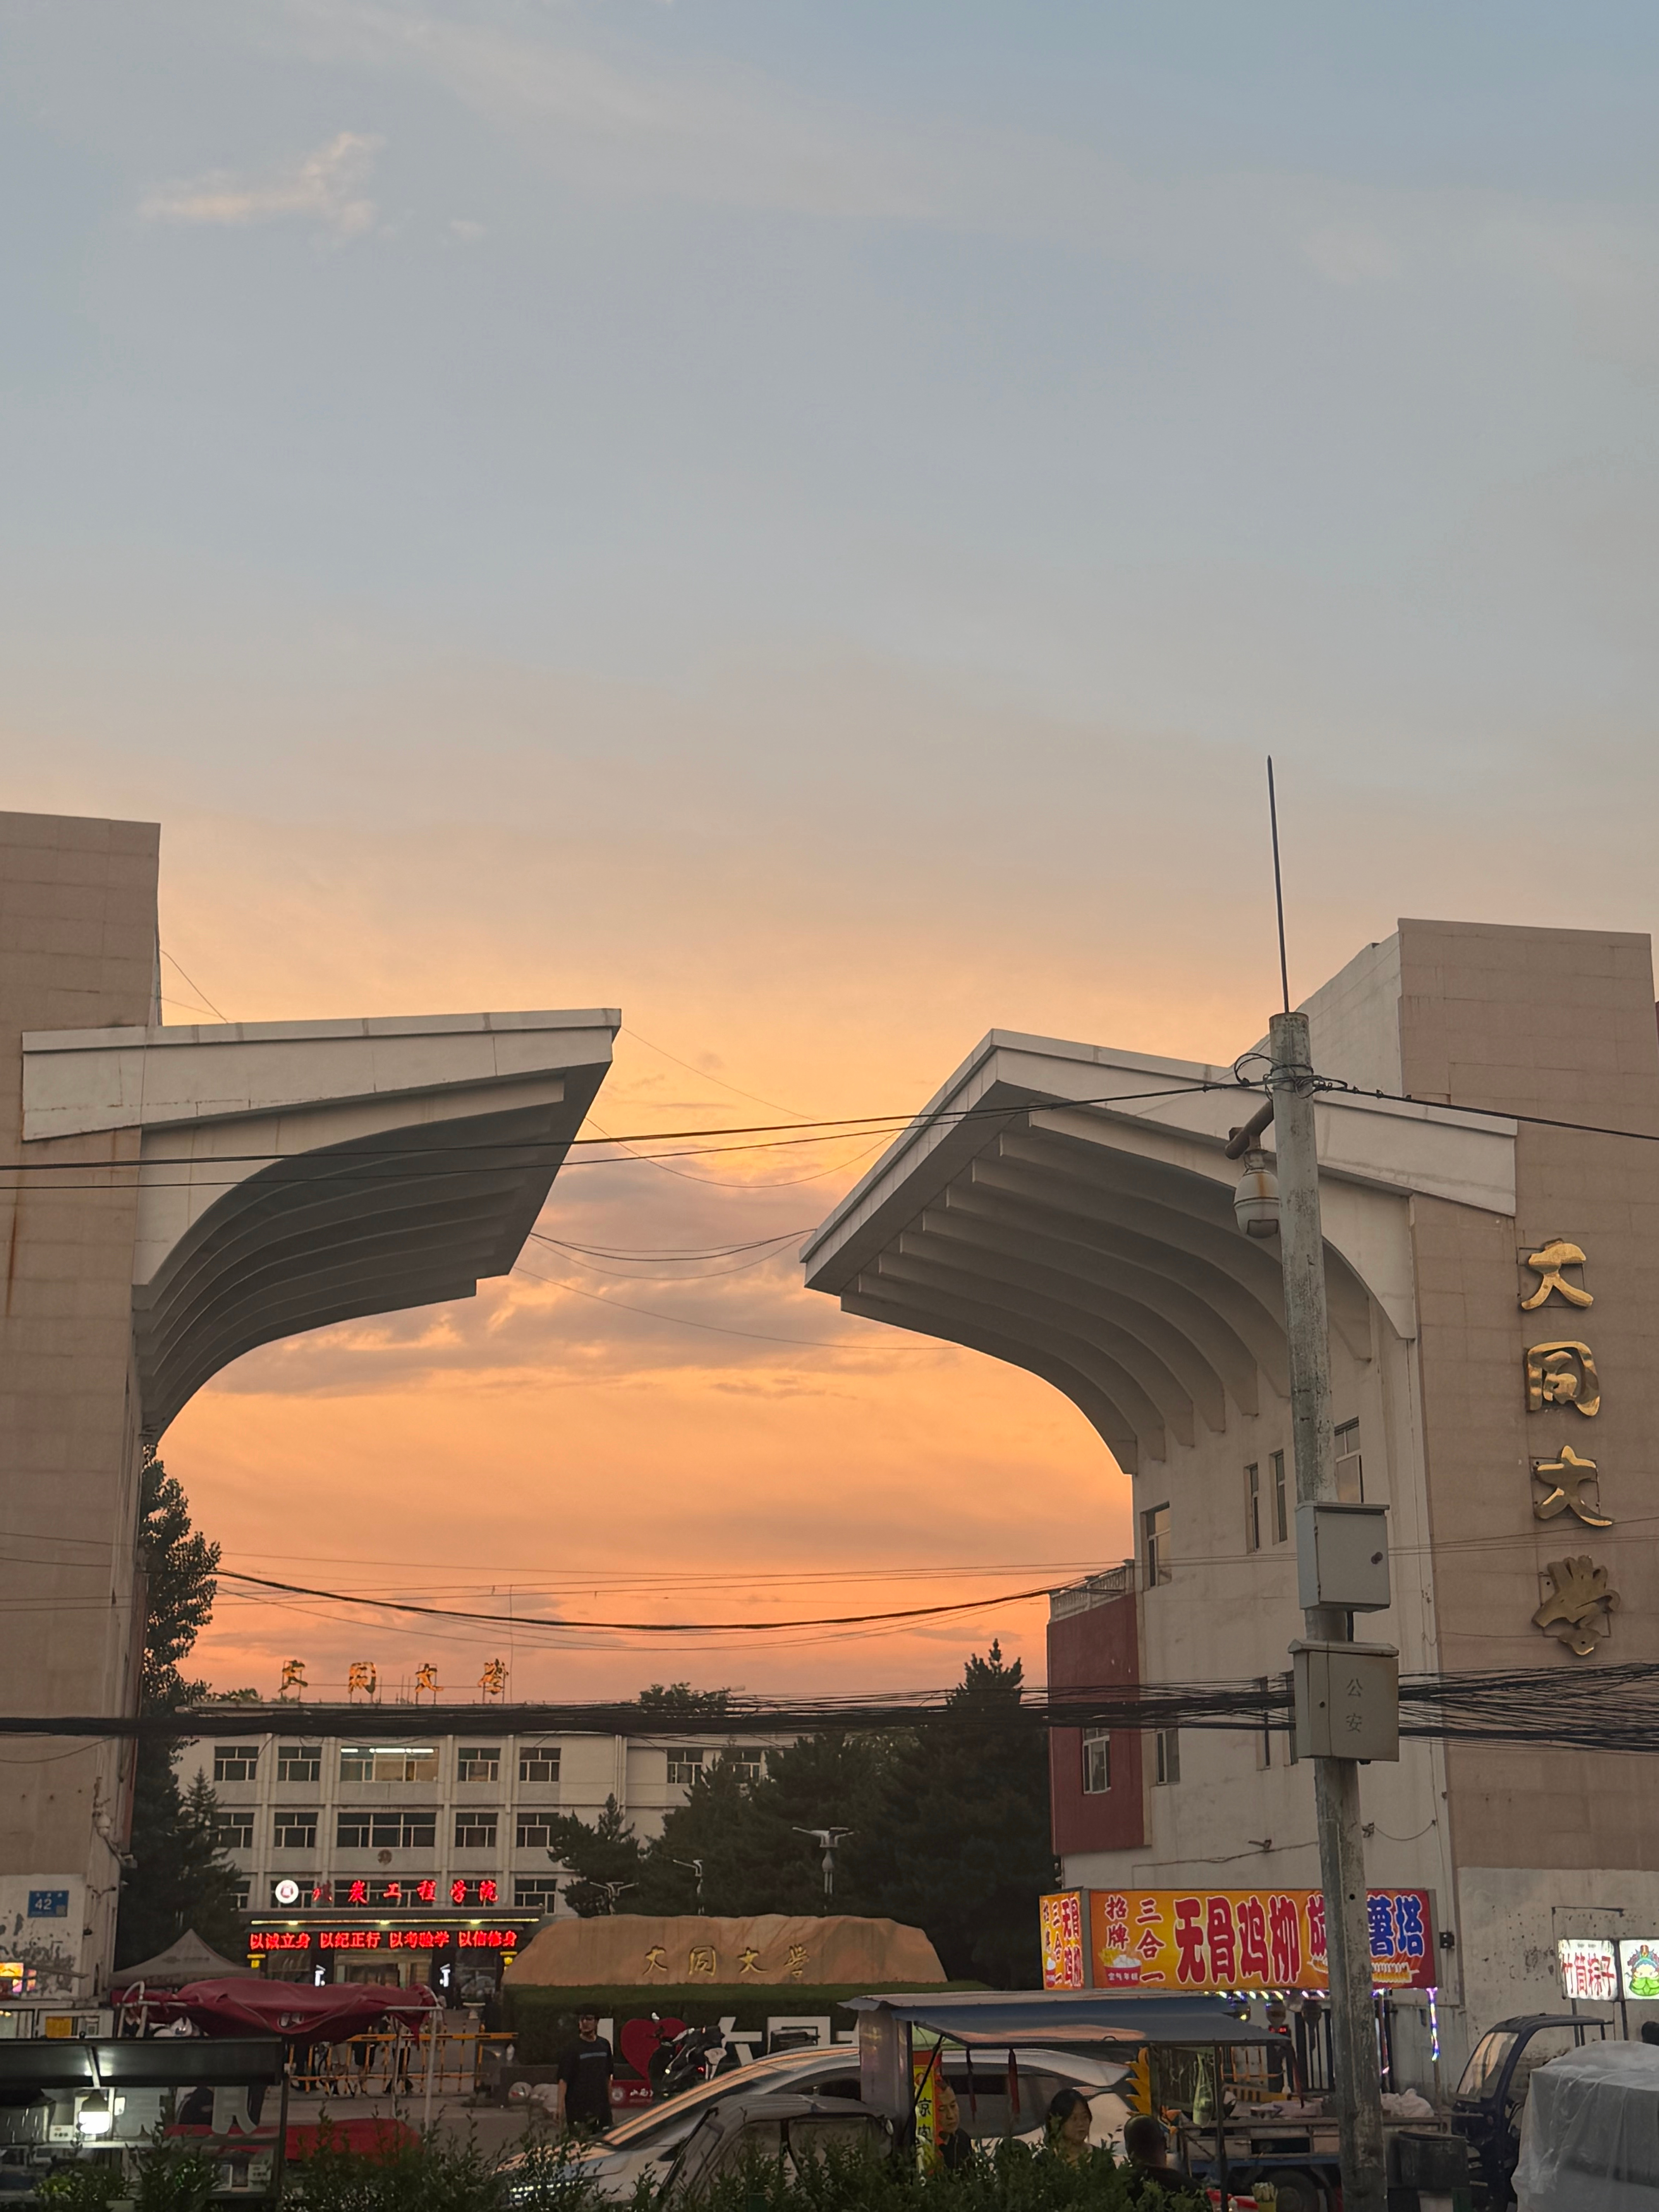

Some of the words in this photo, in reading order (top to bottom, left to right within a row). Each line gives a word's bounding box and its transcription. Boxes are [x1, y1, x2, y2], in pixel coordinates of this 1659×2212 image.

[1520, 1238, 1620, 1656] 大同大学
[277, 1658, 509, 1695] 大同大学
[1346, 1678, 1363, 1733] 公安
[35, 1898, 52, 1910] 42
[312, 1879, 499, 1905] 煤炭工程学院
[1105, 1896, 1131, 1951] 招牌
[1136, 1898, 1166, 1984] 三合一
[1173, 1895, 1302, 1985] 无骨鸡柳
[643, 1944, 809, 1977] 大同大学
